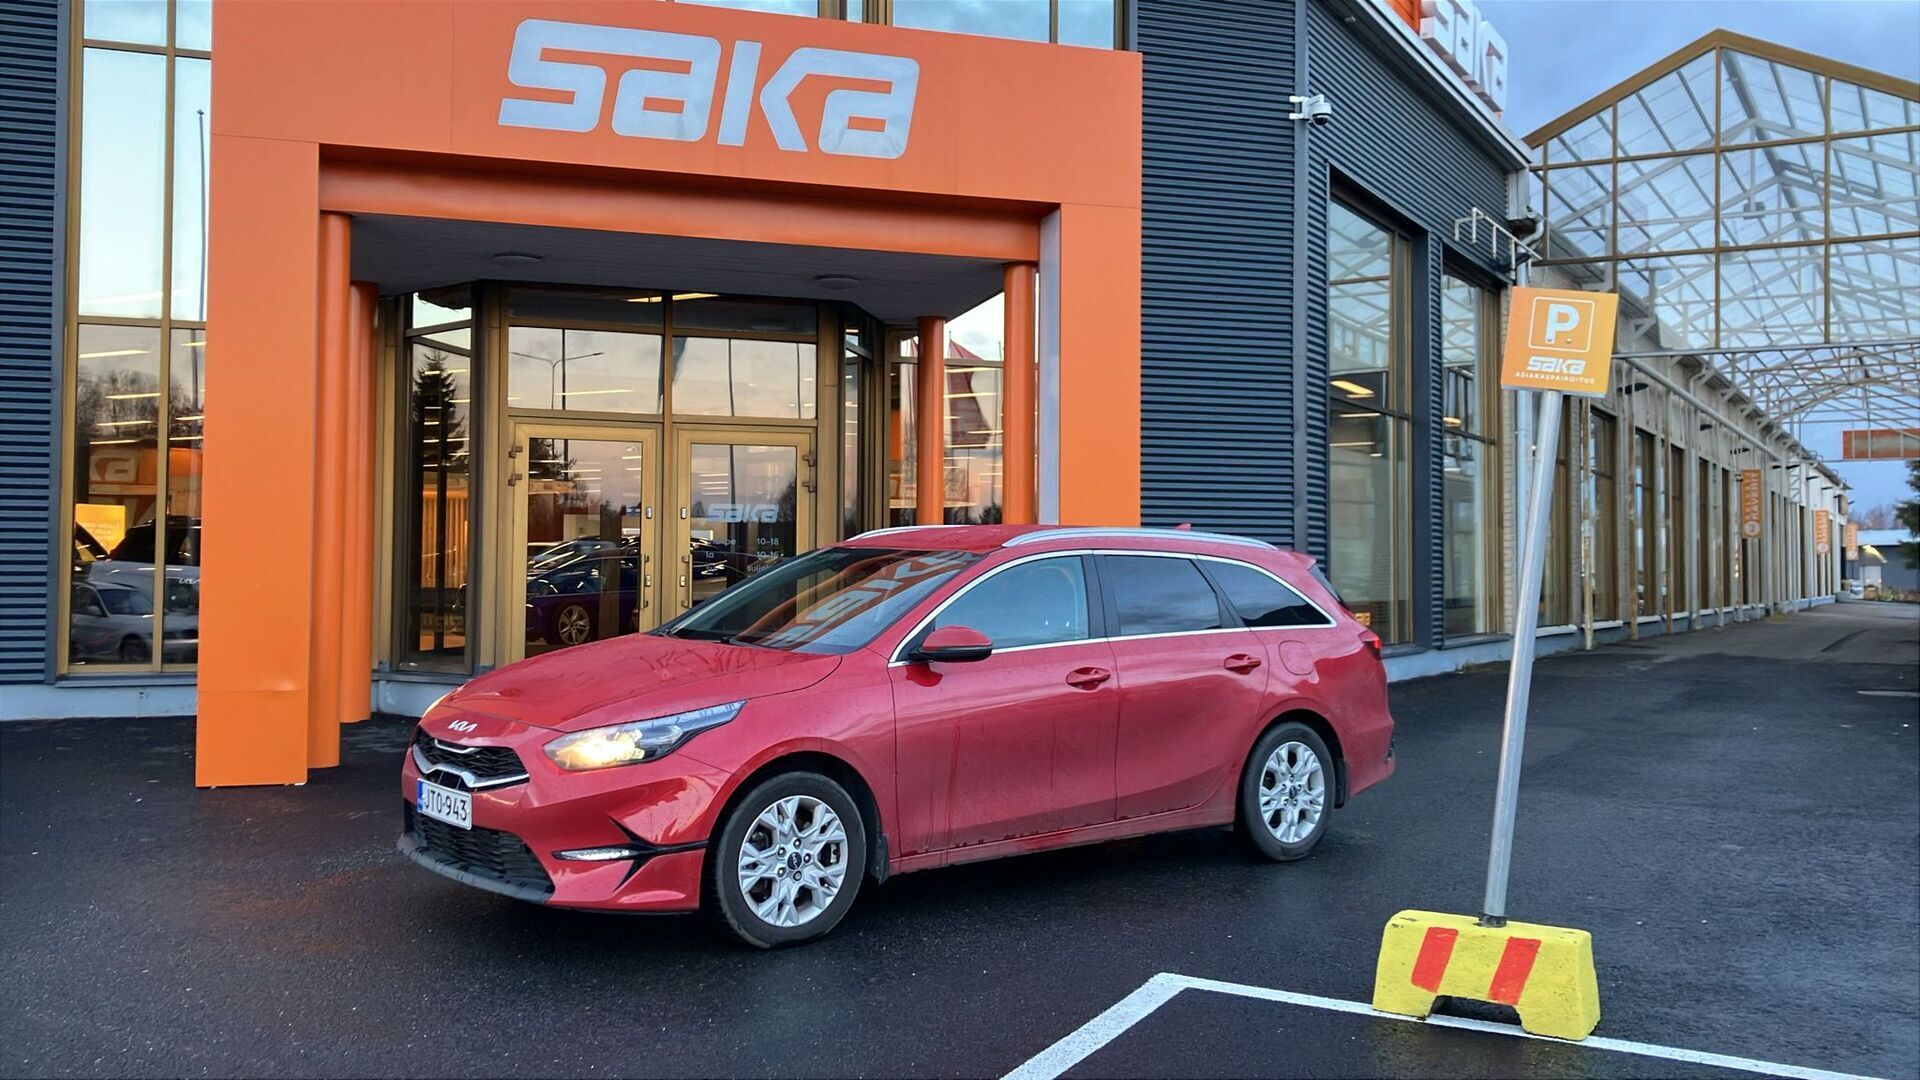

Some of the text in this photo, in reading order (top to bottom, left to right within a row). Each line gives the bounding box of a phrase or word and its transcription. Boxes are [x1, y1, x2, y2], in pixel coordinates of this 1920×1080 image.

[1545, 303, 1580, 344] P
[1515, 371, 1596, 385] ASIAKASPAIKOITUS
[448, 719, 478, 733] KIA
[424, 788, 467, 822] JTO-943
